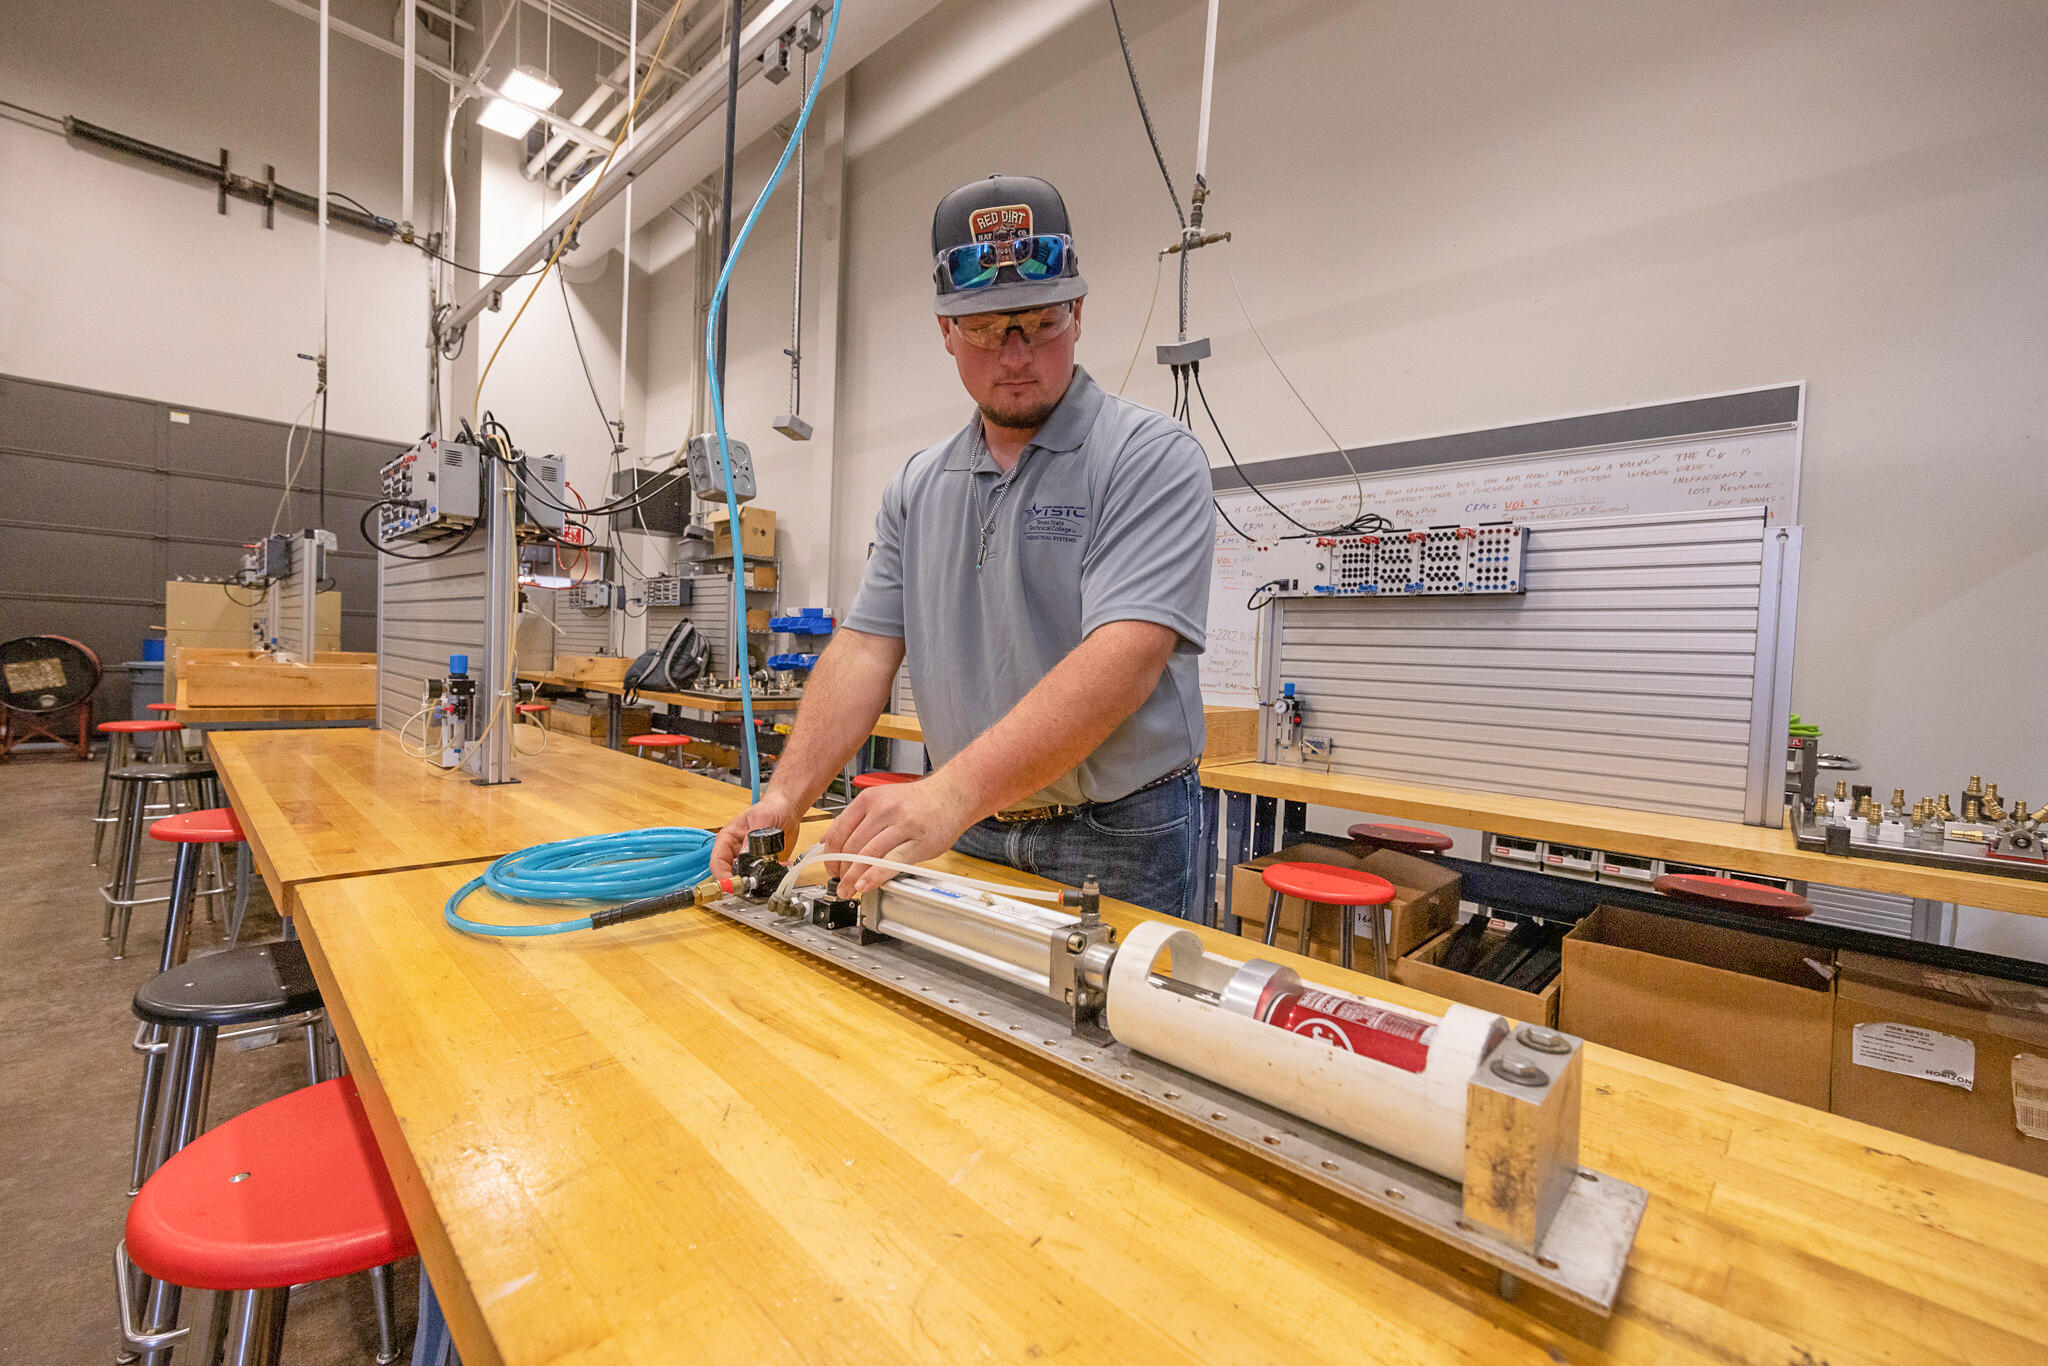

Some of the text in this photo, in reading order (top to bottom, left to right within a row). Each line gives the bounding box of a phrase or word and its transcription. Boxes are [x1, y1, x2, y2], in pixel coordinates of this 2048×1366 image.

[977, 210, 1026, 230] RED DIRT
[978, 233, 993, 241] HAT
[1505, 475, 1521, 483] AIR
[1558, 465, 1601, 476] THROUGH
[1606, 463, 1613, 471] A
[1675, 451, 1698, 462] THE
[1742, 448, 1751, 456] IS
[1573, 474, 1611, 484] SYSTEM
[1627, 469, 1670, 478] WRONG
[1688, 487, 1711, 496] LOST
[1719, 482, 1773, 493] REVENUE
[1504, 501, 1525, 511] VOL
[1707, 499, 1736, 507] LOST
[1051, 525, 1072, 534] College
[1053, 535, 1077, 543] SYSTEMS
[1925, 1069, 1973, 1086] HORIZON
